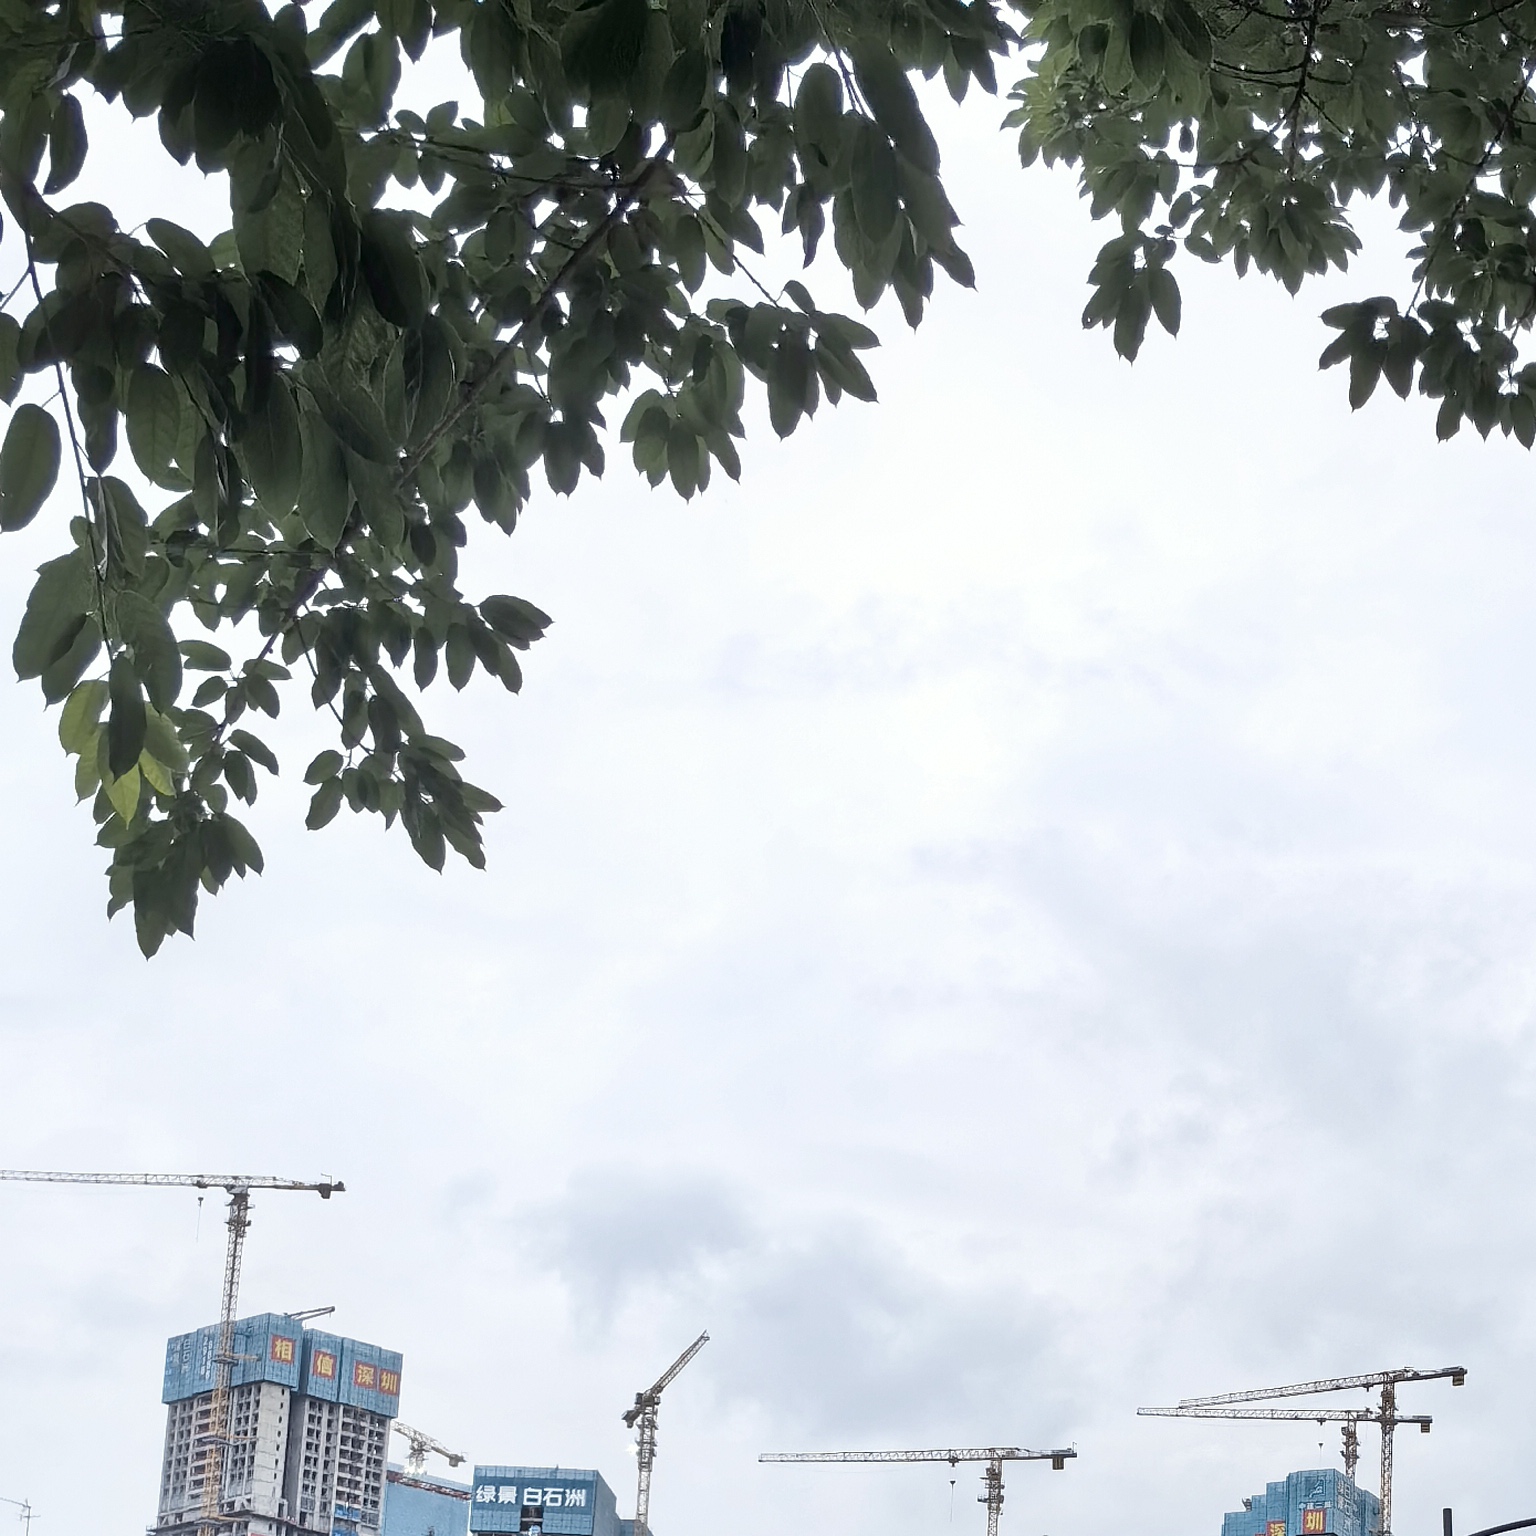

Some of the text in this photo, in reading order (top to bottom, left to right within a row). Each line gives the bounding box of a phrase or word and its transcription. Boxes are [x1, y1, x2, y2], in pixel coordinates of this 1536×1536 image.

[274, 1338, 399, 1393] 相信深圳
[475, 1485, 586, 1507] 绿景 白石洲
